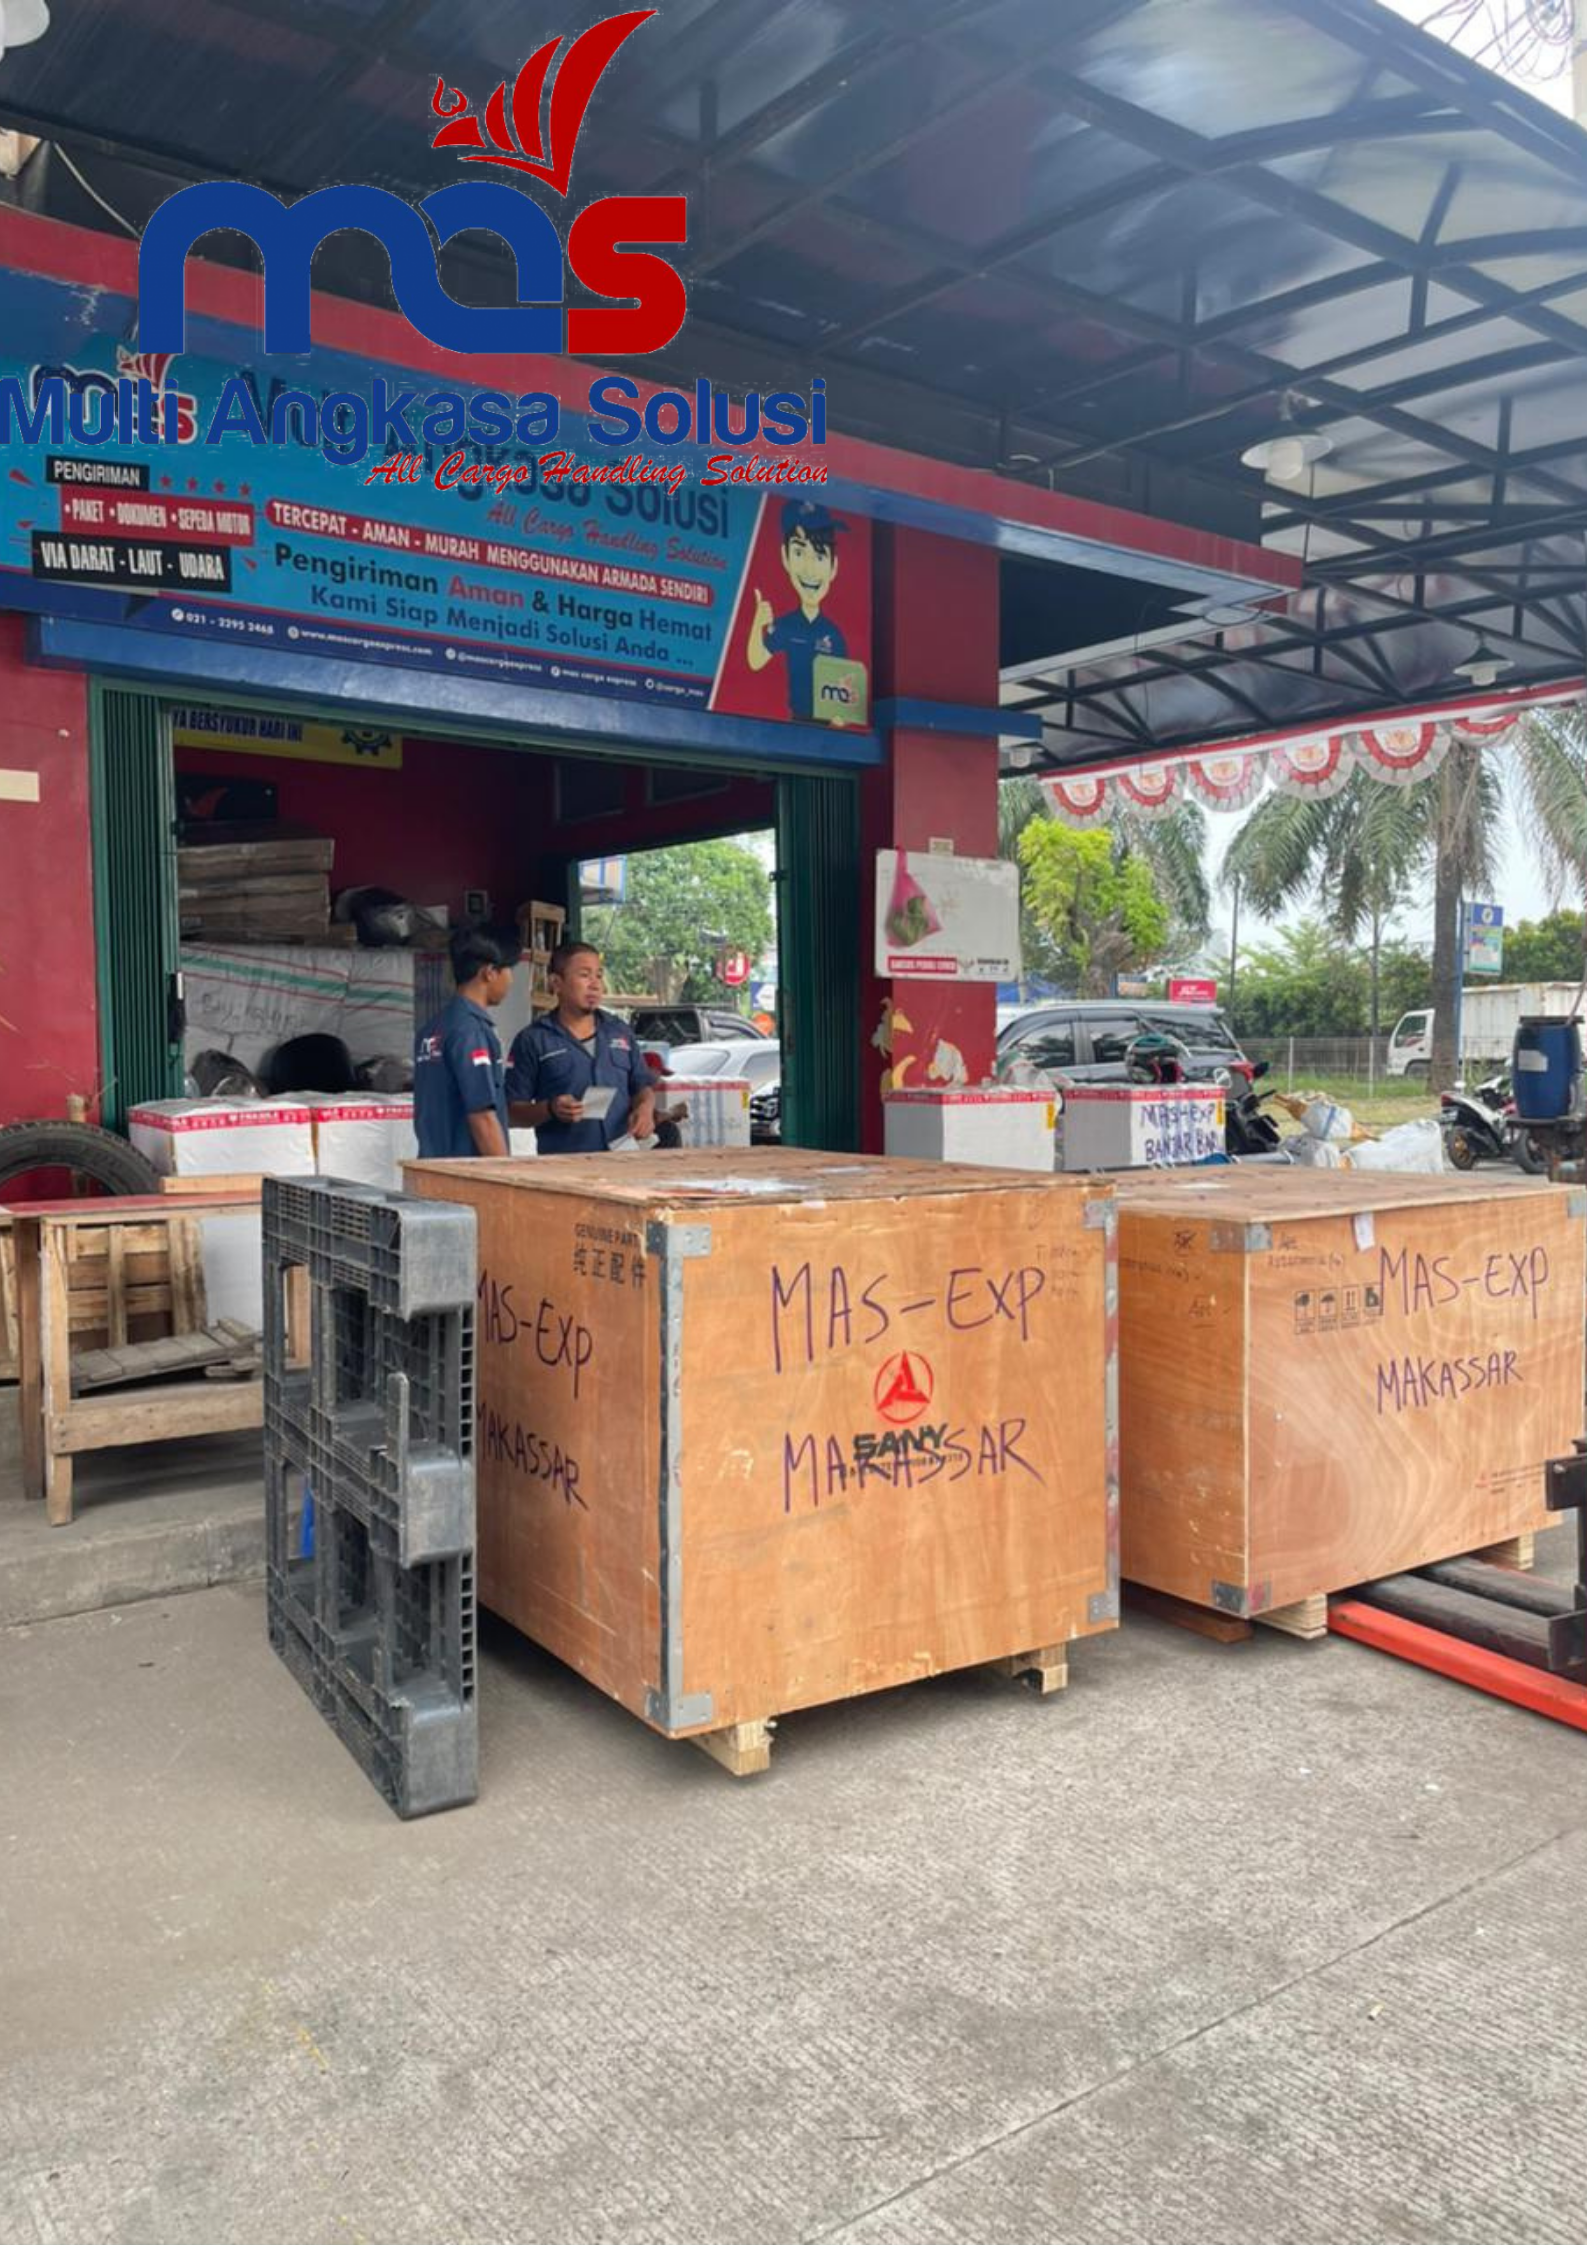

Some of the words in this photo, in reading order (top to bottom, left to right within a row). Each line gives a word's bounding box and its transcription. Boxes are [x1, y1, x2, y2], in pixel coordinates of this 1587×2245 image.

[53, 460, 140, 486] PENGIRIMAN
[72, 498, 104, 523] PAKET
[487, 499, 517, 527] All
[523, 507, 574, 539] Cargo
[581, 518, 659, 560] Handling
[41, 541, 67, 569] VIA
[69, 545, 115, 573] DARAT
[128, 548, 163, 576] LAUT
[179, 552, 225, 580] UDARA
[272, 502, 347, 535] TERCEPAT
[362, 521, 410, 547] AMAN
[425, 533, 480, 563] MURAH
[486, 544, 599, 584] MENGGUNAKAN
[602, 562, 657, 595] ARMADA
[660, 577, 709, 604] SENDIRI
[186, 612, 206, 625] 021
[274, 543, 438, 595] Pengiriman
[449, 575, 525, 610] Aman
[532, 590, 550, 612] &
[557, 589, 633, 629] Harga
[639, 610, 712, 642] Hemat
[311, 586, 377, 616] Kami
[387, 596, 438, 628] Siap
[447, 608, 540, 640] Menjadi
[546, 623, 608, 652] Solusi
[614, 637, 669, 662] Anda
[575, 1223, 613, 1244] GENUINE
[1379, 1246, 1550, 1320] MAS-EXP
[771, 1262, 1046, 1375] MAS-EXP
[1377, 1350, 1525, 1415] MAKASSAR
[783, 1418, 1047, 1513] MAKASSAR
[852, 1423, 949, 1461] SANY
